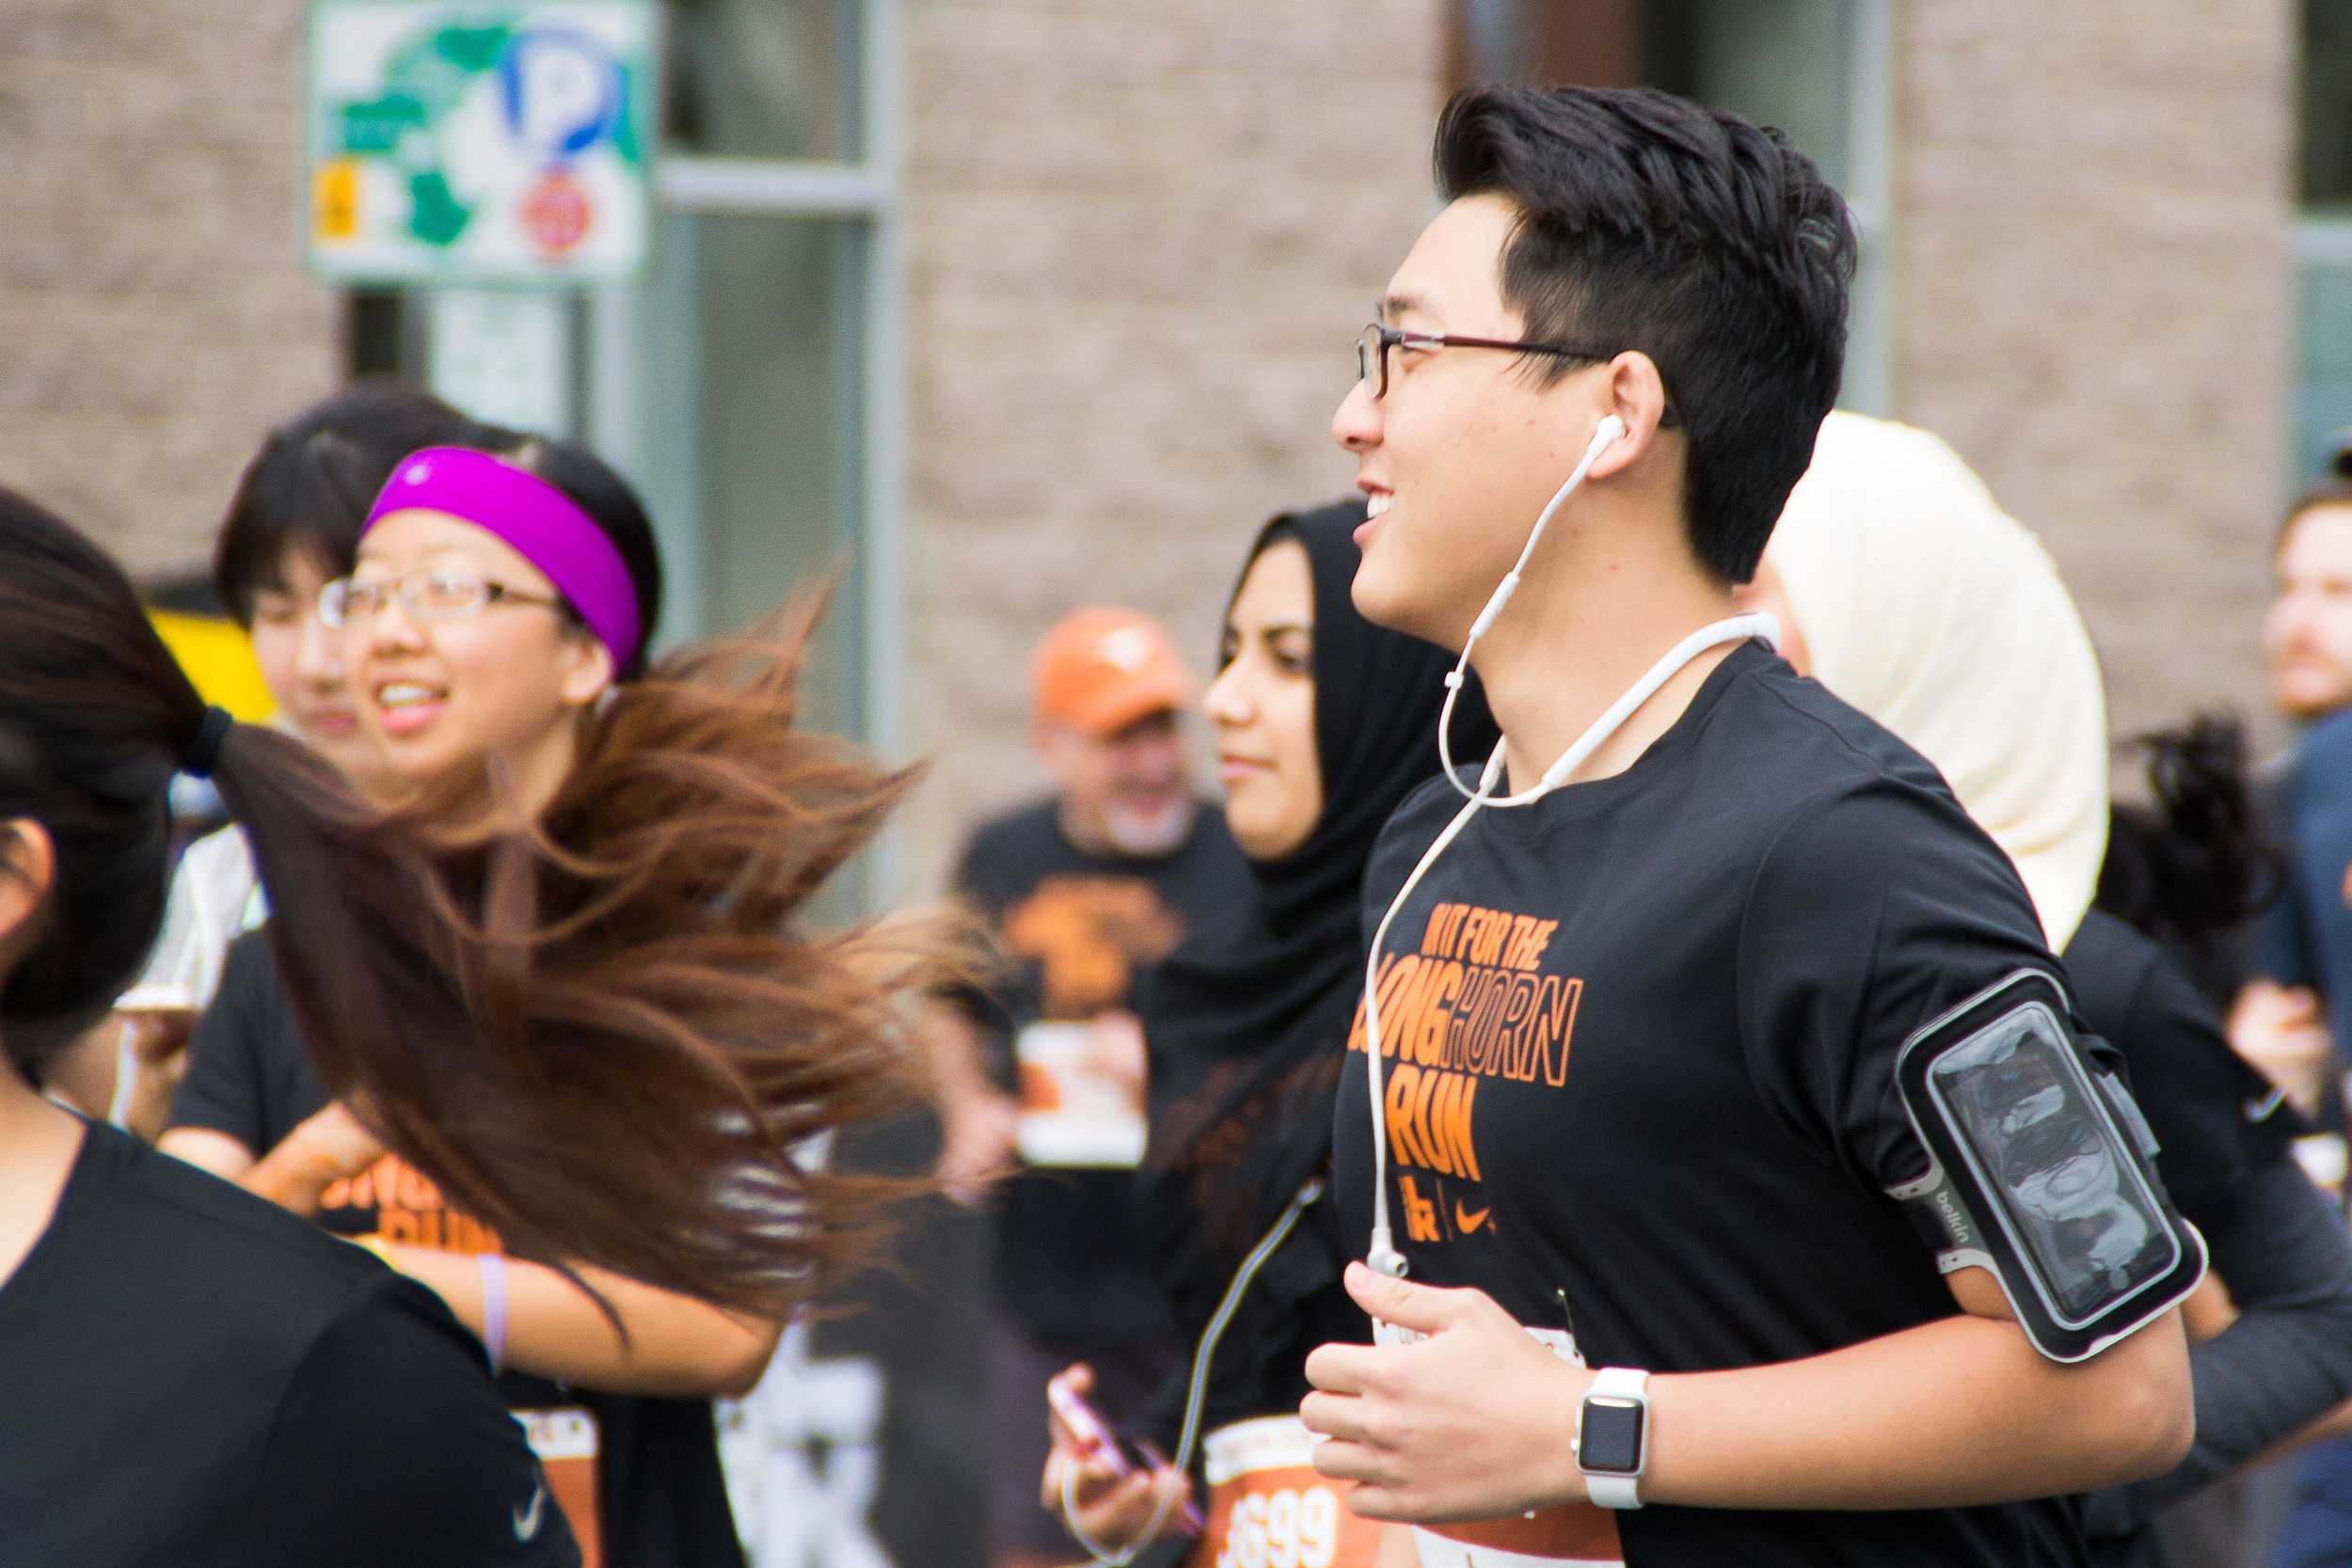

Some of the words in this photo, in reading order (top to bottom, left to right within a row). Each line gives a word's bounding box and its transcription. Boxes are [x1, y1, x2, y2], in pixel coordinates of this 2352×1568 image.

[1455, 906, 1514, 966] FOR
[1501, 914, 1560, 972] THE
[1384, 1064, 1482, 1182] RUN
[1936, 1190, 1970, 1243] belkin
